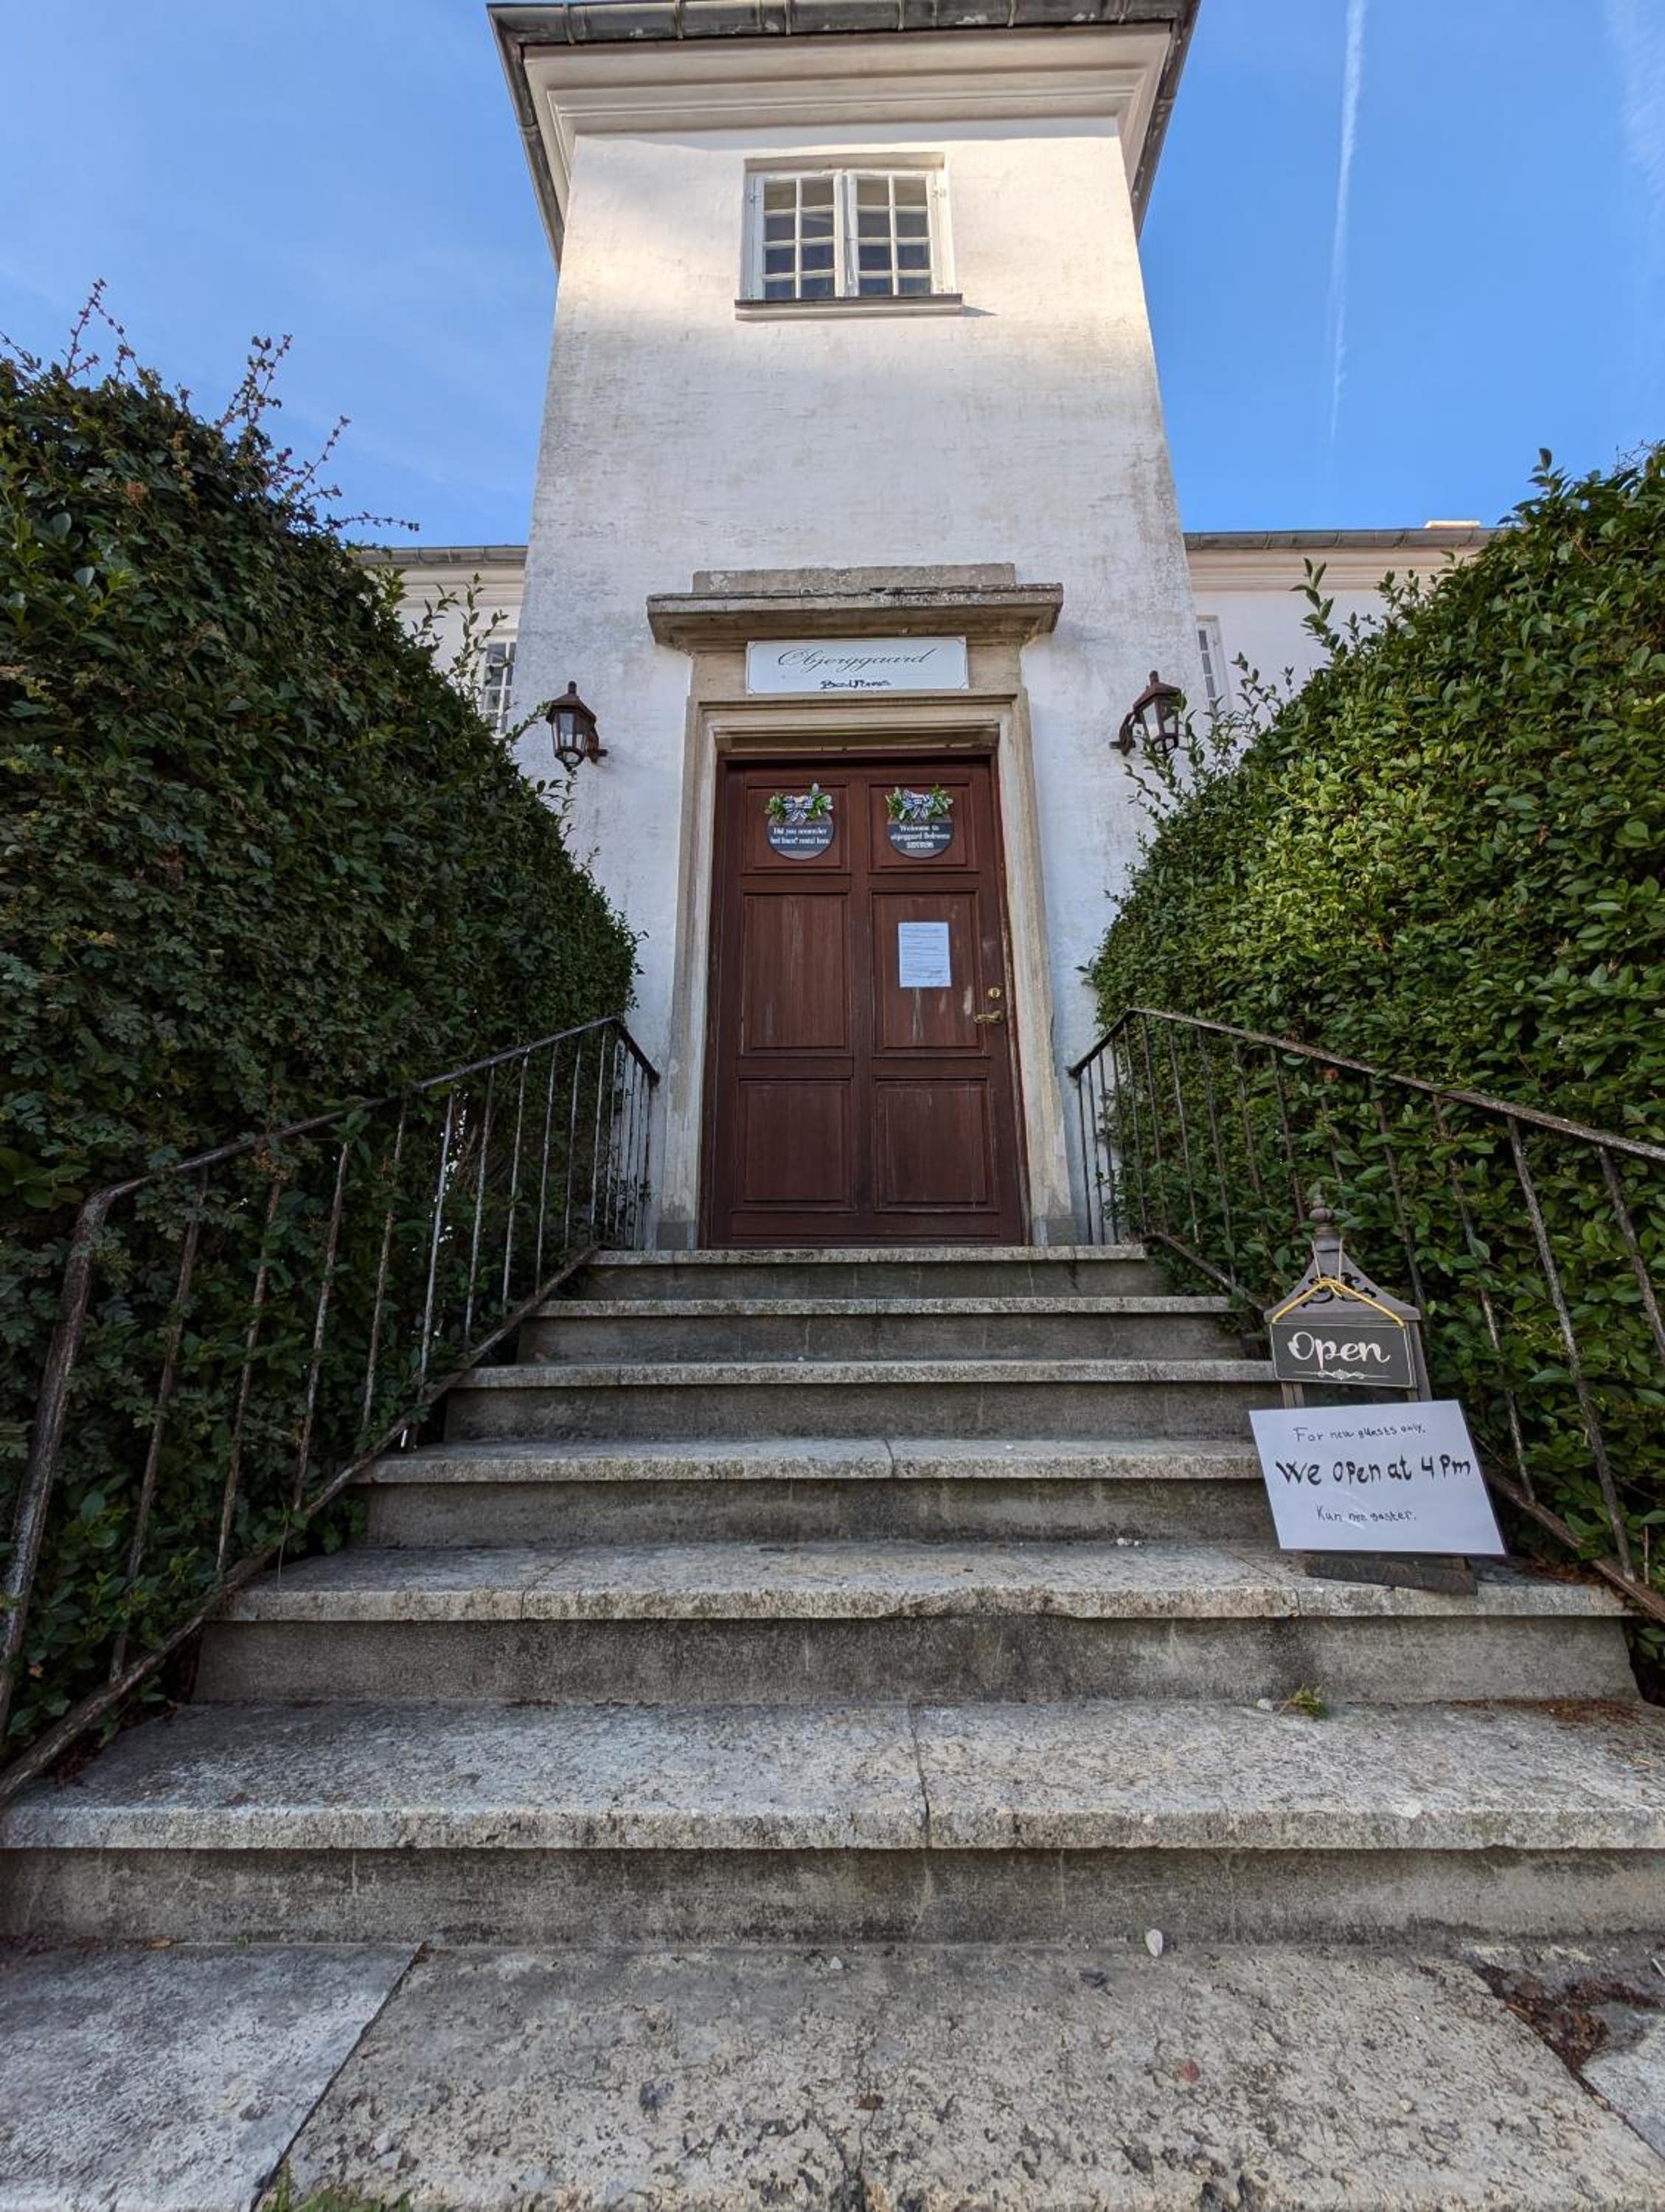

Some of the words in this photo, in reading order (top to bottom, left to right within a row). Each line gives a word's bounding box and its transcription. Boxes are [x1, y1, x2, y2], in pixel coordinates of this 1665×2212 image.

[785, 829, 797, 837] you
[1287, 1331, 1391, 1370] Open
[1293, 1426, 1324, 1442] For
[1275, 1460, 1322, 1486] We
[1387, 1454, 1412, 1481] at
[1420, 1455, 1434, 1479] 4
[1315, 1504, 1343, 1522] Kun
